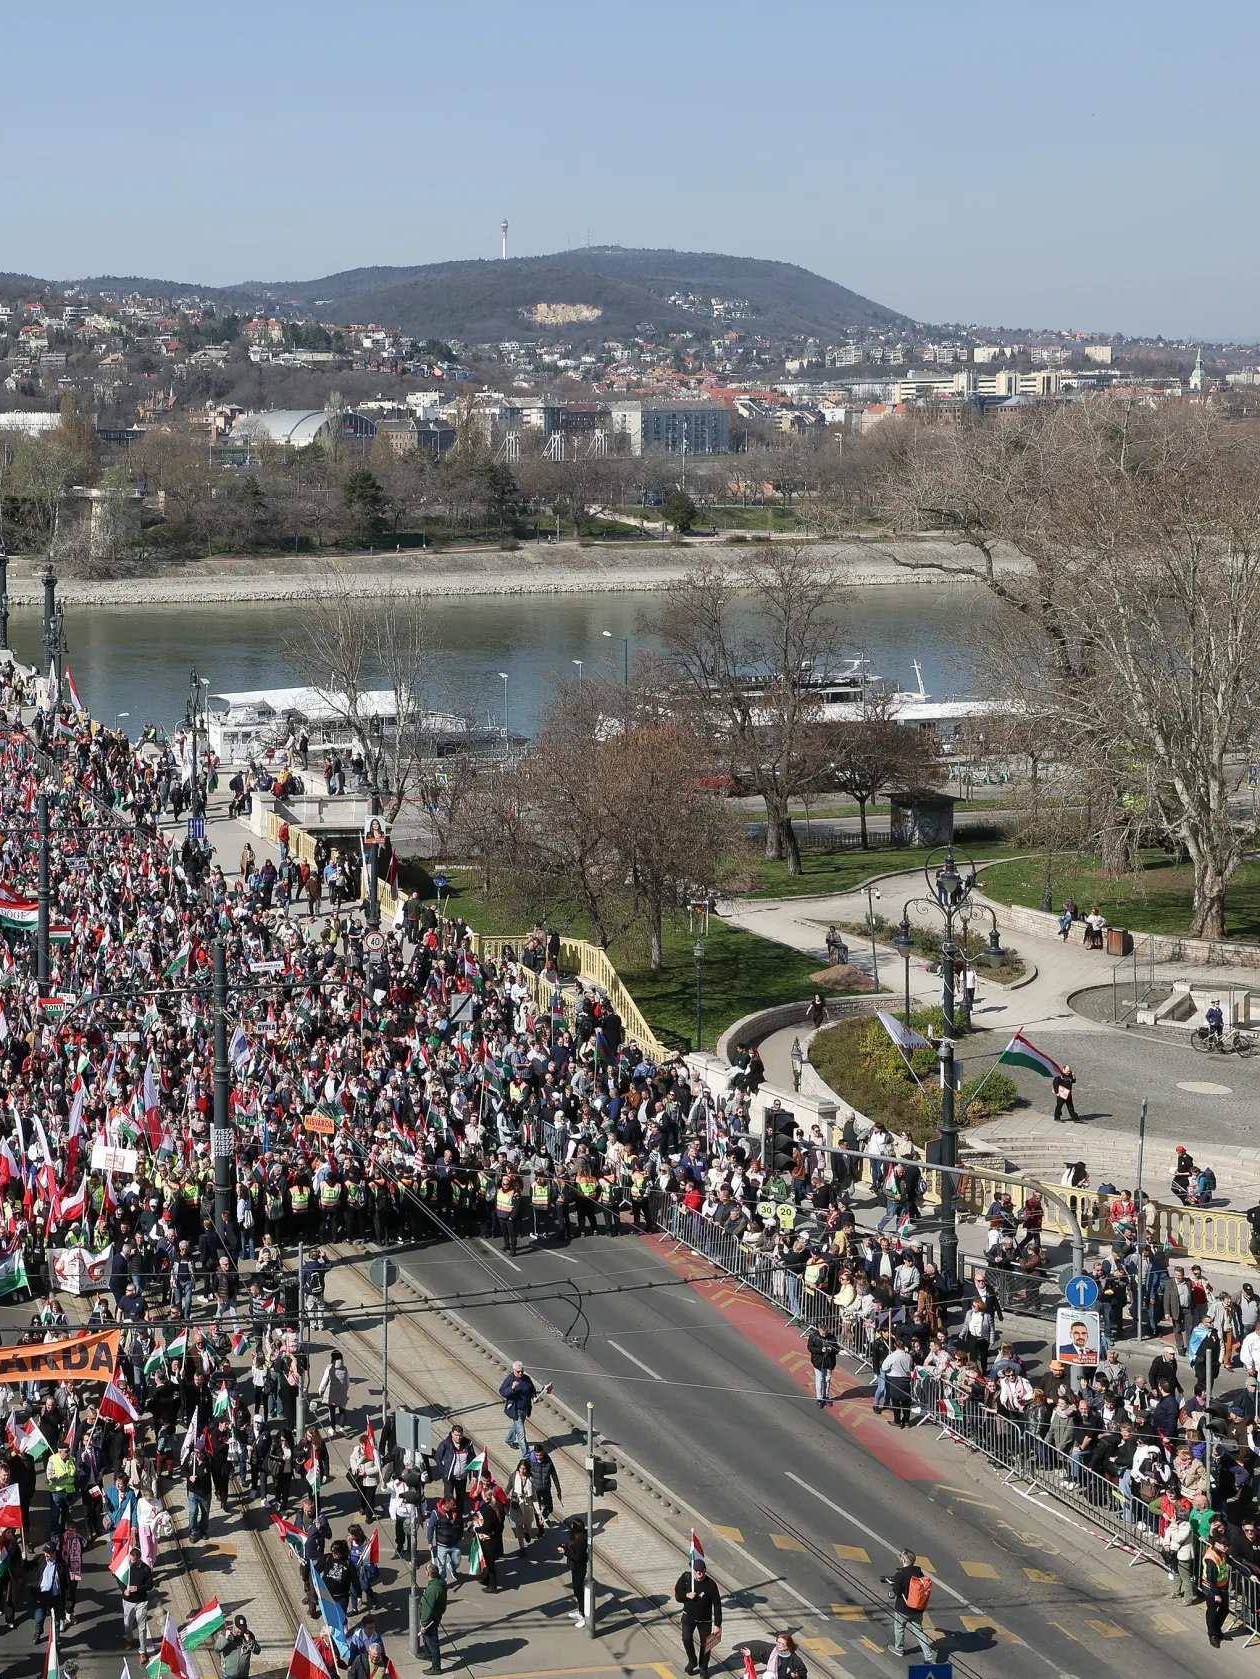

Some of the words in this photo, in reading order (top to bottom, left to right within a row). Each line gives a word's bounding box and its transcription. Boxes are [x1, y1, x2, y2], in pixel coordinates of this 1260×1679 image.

[370, 937, 380, 946] 40
[761, 1206, 772, 1214] 30
[780, 1208, 792, 1216] 20
